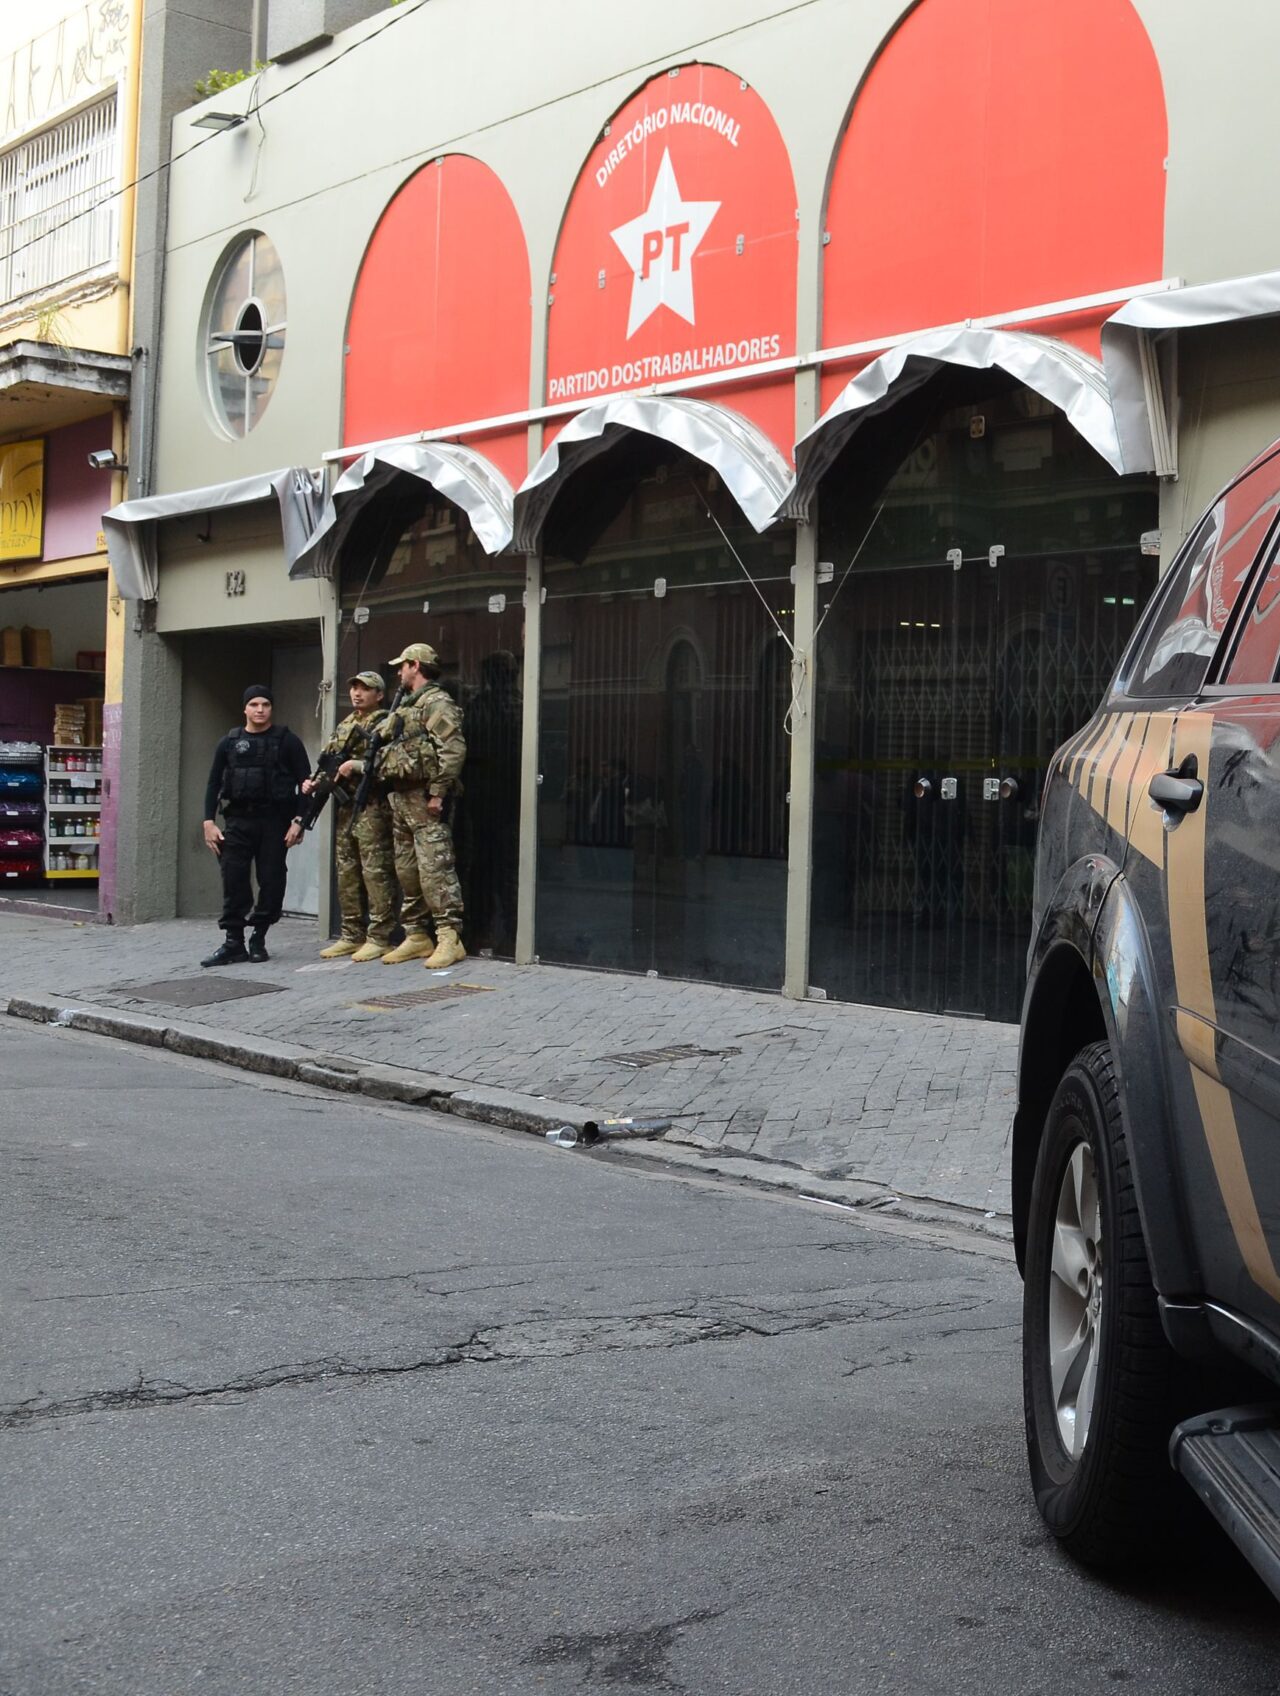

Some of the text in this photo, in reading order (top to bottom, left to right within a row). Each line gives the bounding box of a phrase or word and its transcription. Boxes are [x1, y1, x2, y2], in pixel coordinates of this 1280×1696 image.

[595, 102, 741, 187] DIRETÓRIO NACIONAL
[641, 221, 690, 280] PT
[549, 367, 609, 399] PARTIDO
